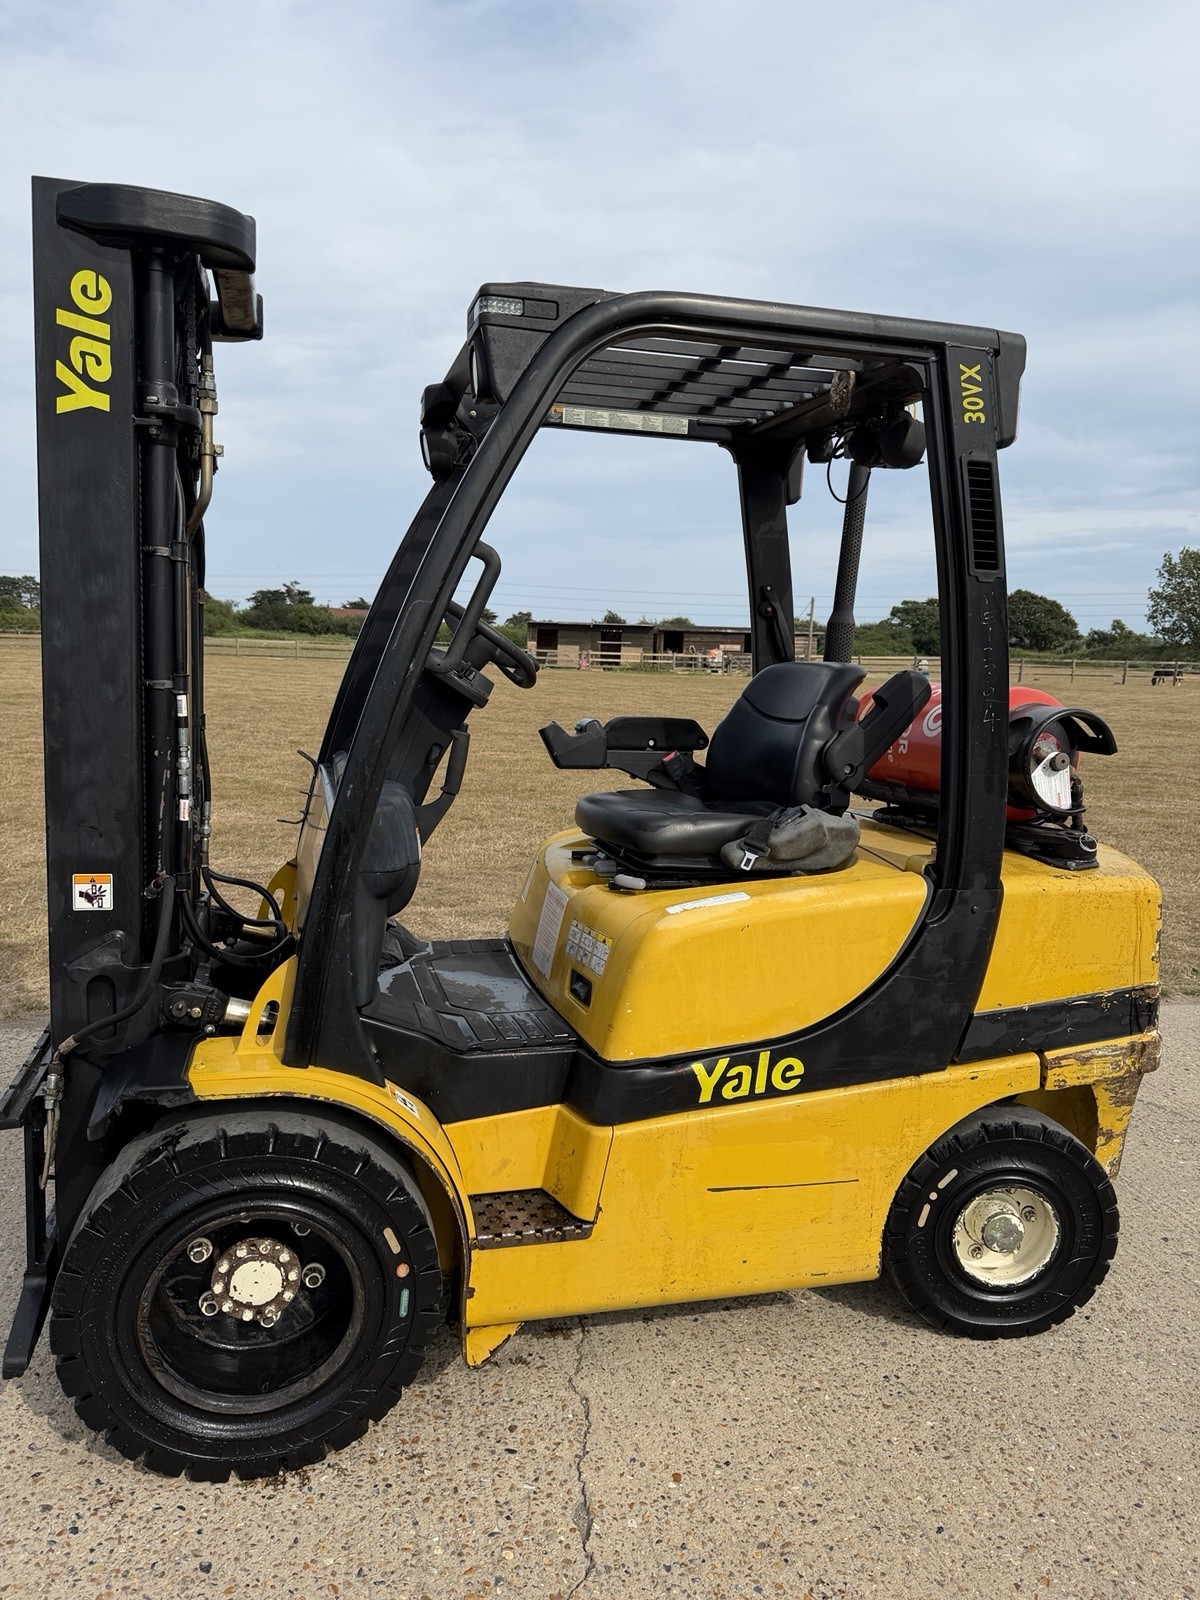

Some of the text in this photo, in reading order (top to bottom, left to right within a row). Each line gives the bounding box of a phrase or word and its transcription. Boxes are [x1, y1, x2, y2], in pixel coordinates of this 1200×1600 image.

[55, 269, 112, 414] Yale
[959, 363, 985, 425] 30VX
[691, 1050, 805, 1104] Yale
